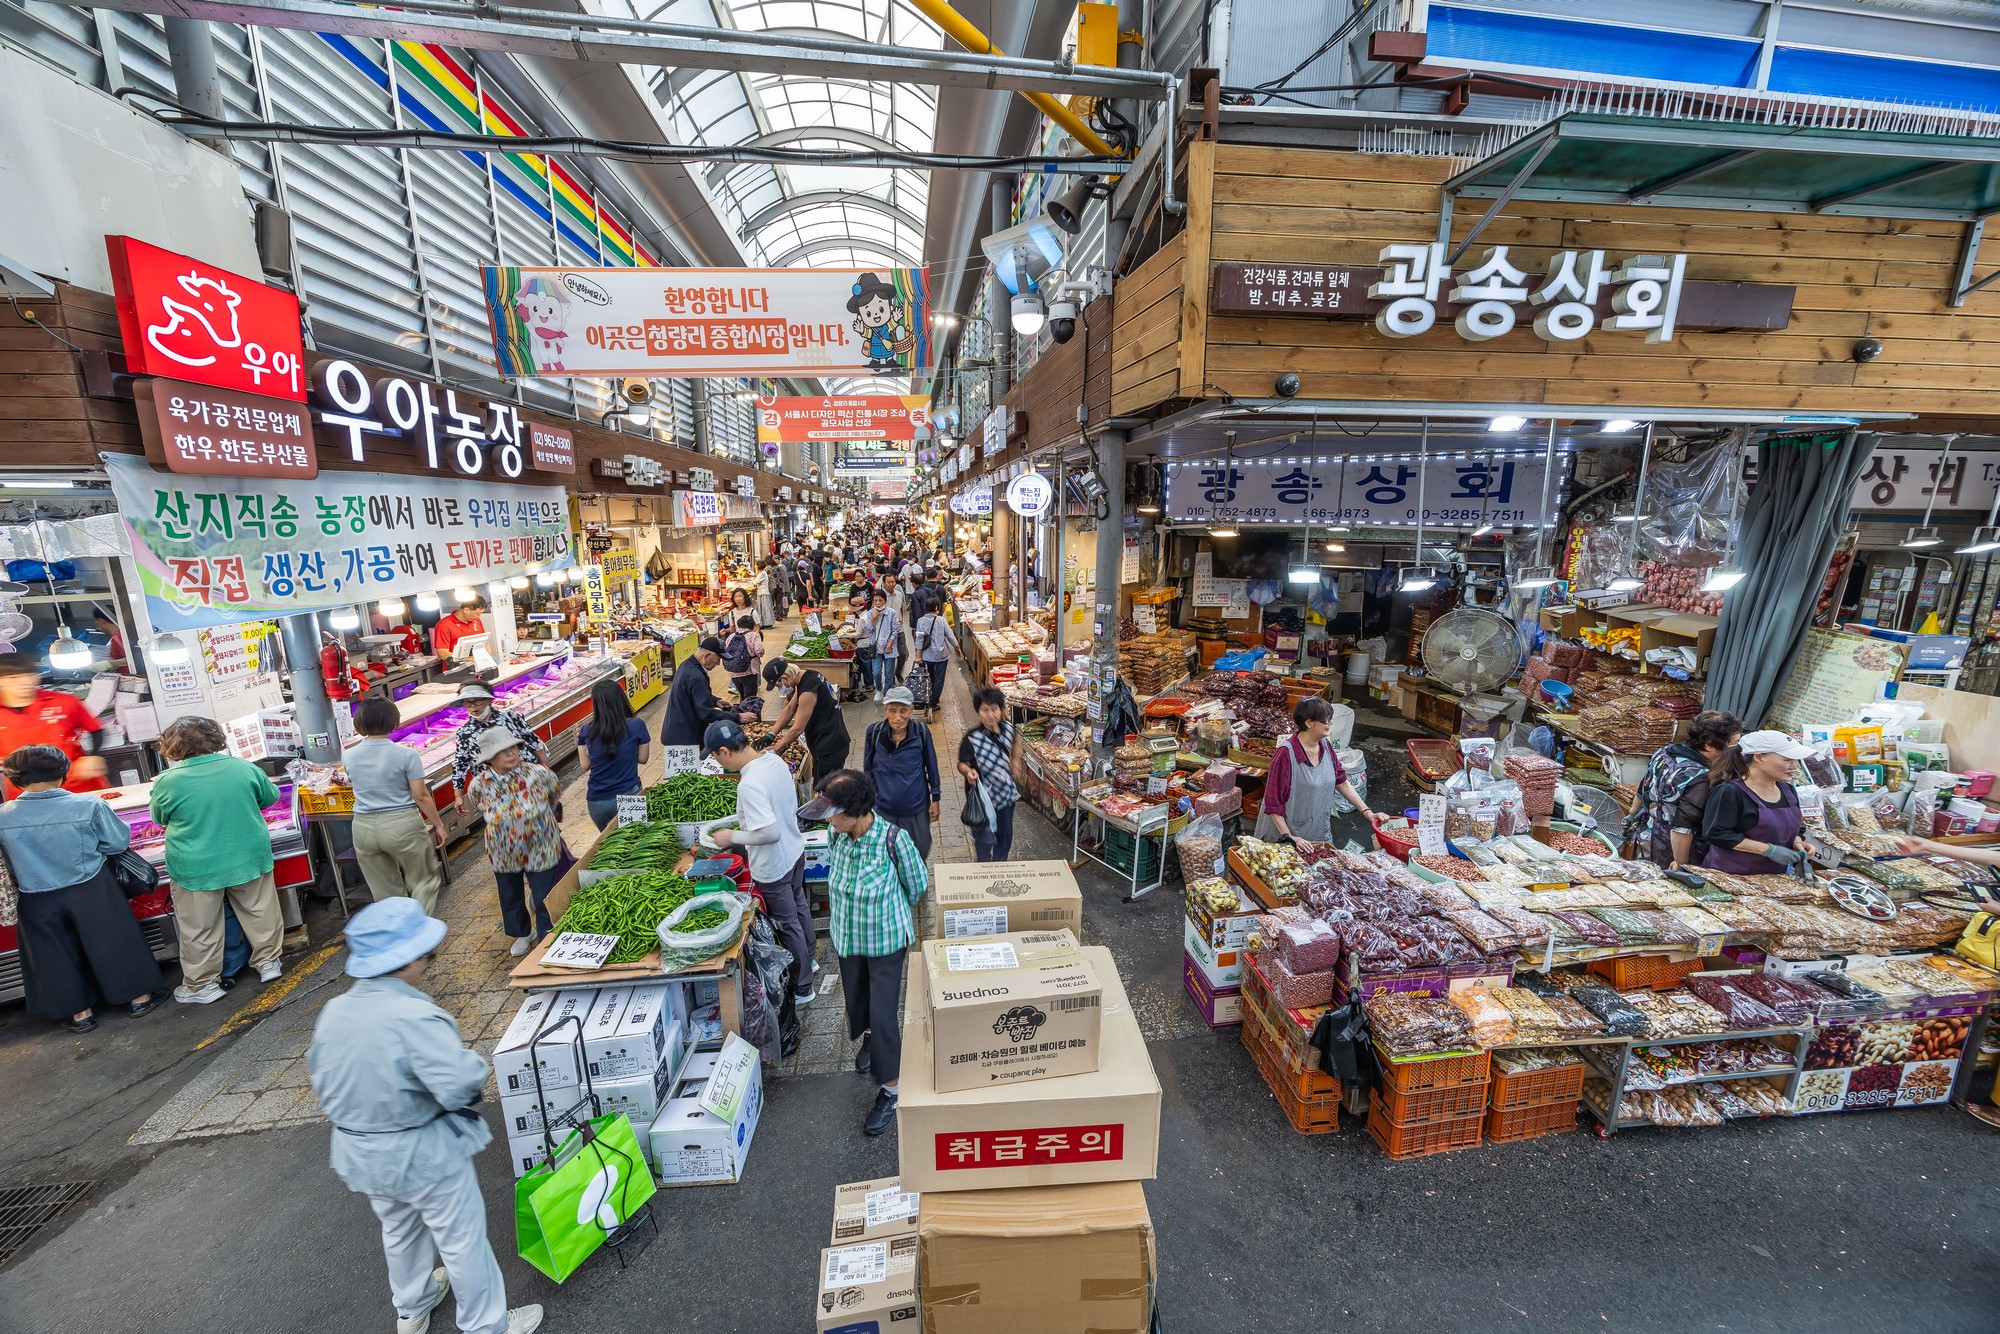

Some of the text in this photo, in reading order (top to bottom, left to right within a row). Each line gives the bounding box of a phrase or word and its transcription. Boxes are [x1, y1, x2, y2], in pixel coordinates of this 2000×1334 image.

[1243, 267, 1350, 290] 건강식품.견과류 일체
[566, 278, 606, 303] 안녕하세요!
[664, 286, 769, 315] 환영합니다
[1248, 288, 1343, 309] 밤.대추.곶감
[1376, 243, 1688, 342] 광송상회
[585, 322, 850, 352] 이곳은 청량리 종합시장입니다.
[241, 342, 302, 393] 우아
[168, 396, 302, 437] 육가공전문업체
[321, 359, 525, 478] 우아농장
[763, 412, 778, 426] 경
[784, 409, 907, 419] 서울시 디자인 혁신 전통시장 조성
[820, 418, 872, 428] 공모사업 선정
[912, 410, 925, 424] 축
[174, 433, 309, 467] 한우.한돈.부산물
[533, 431, 572, 451] 02) 962-0300
[1197, 461, 1516, 505] 광송상회
[1859, 455, 1968, 507] 상회
[153, 488, 561, 541] 산지직송 농장에서 바로 우리집 식탁으로
[1186, 505, 1277, 519] 010-7752-4873
[1405, 507, 1525, 522] 010-3285-7511
[167, 530, 569, 606] 직접 생산,가공하여 도매가로 판매합니다
[586, 566, 605, 614] 홍어무침
[244, 628, 264, 639] 7,000
[247, 644, 258, 654] 6,0
[248, 659, 257, 668] 10
[942, 987, 1009, 1002] coupang
[949, 1037, 1087, 1065] 김희애·차승원의 힐링 베이킹 예능
[981, 1060, 993, 1068] 지금
[1000, 1066, 1047, 1080] coupang play
[1807, 1086, 1938, 1109] 010-3285-7511
[948, 1129, 1113, 1163] 취급주의
[839, 1183, 872, 1194] Bebesup
[839, 1218, 862, 1228] 파손주의
